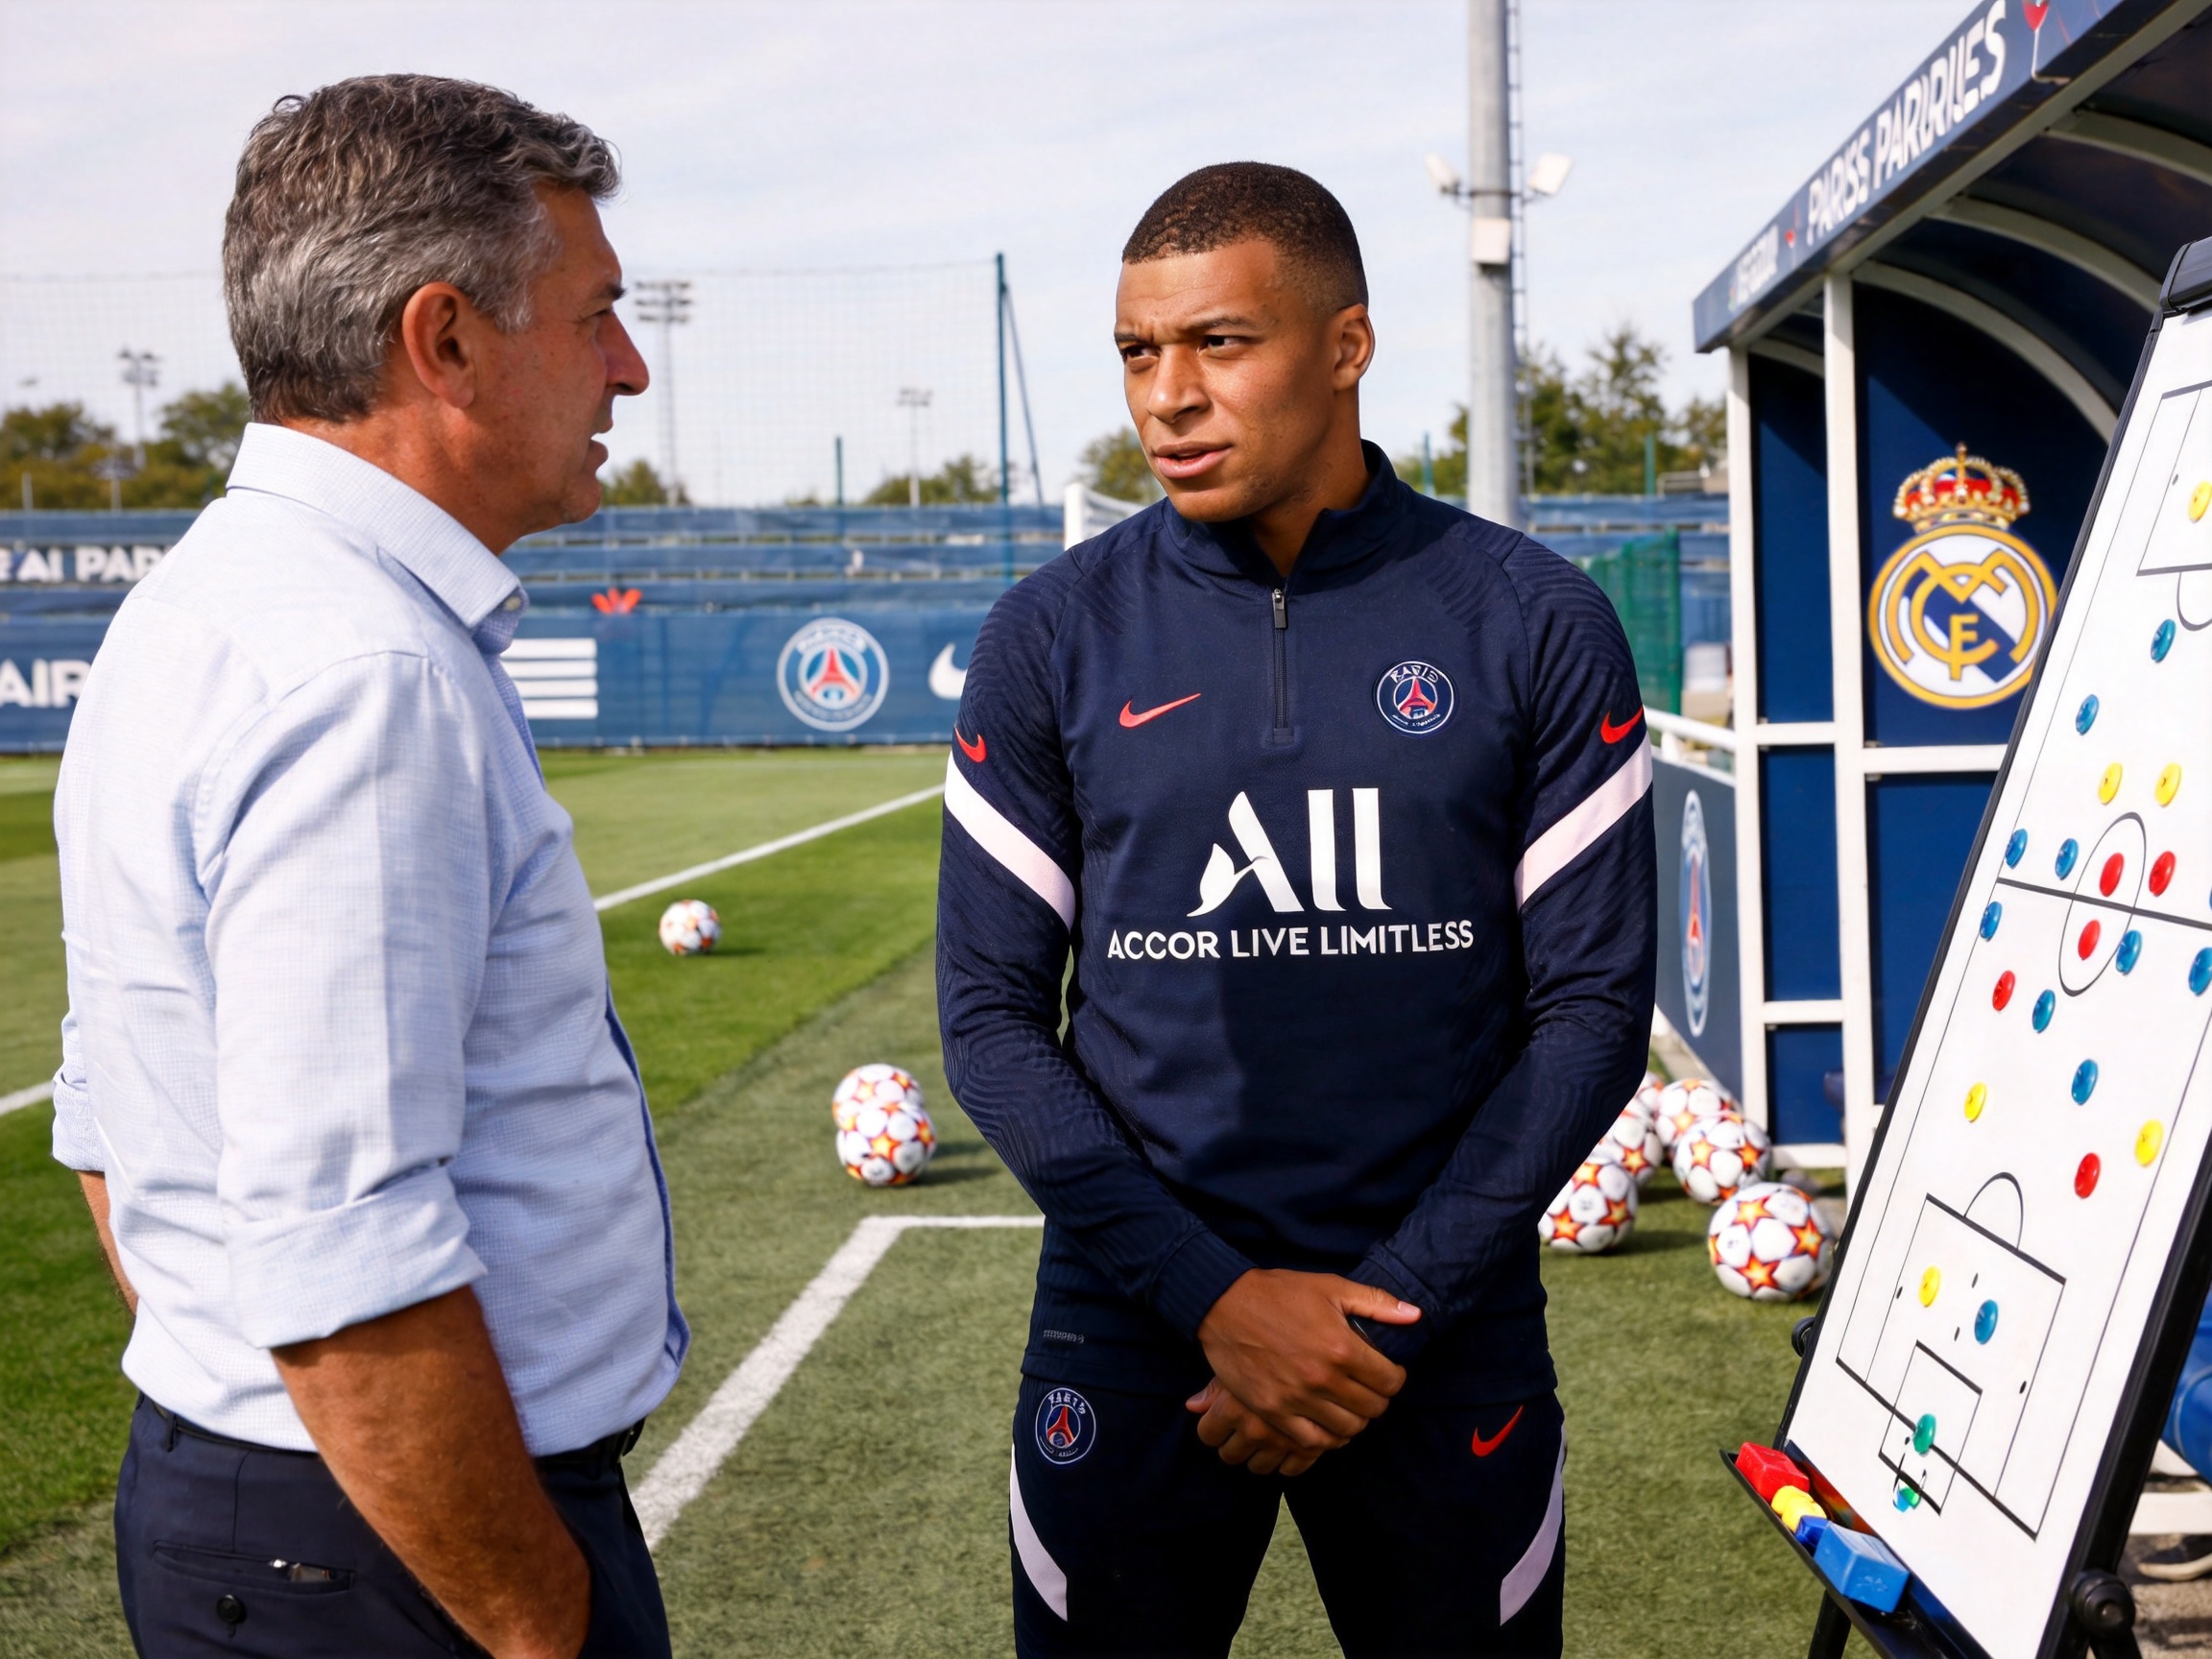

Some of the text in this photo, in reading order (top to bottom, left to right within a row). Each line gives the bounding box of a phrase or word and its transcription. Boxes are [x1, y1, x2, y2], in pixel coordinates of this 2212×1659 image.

[1107, 919, 1475, 960] ACCOR LIVE LIMITLESS
